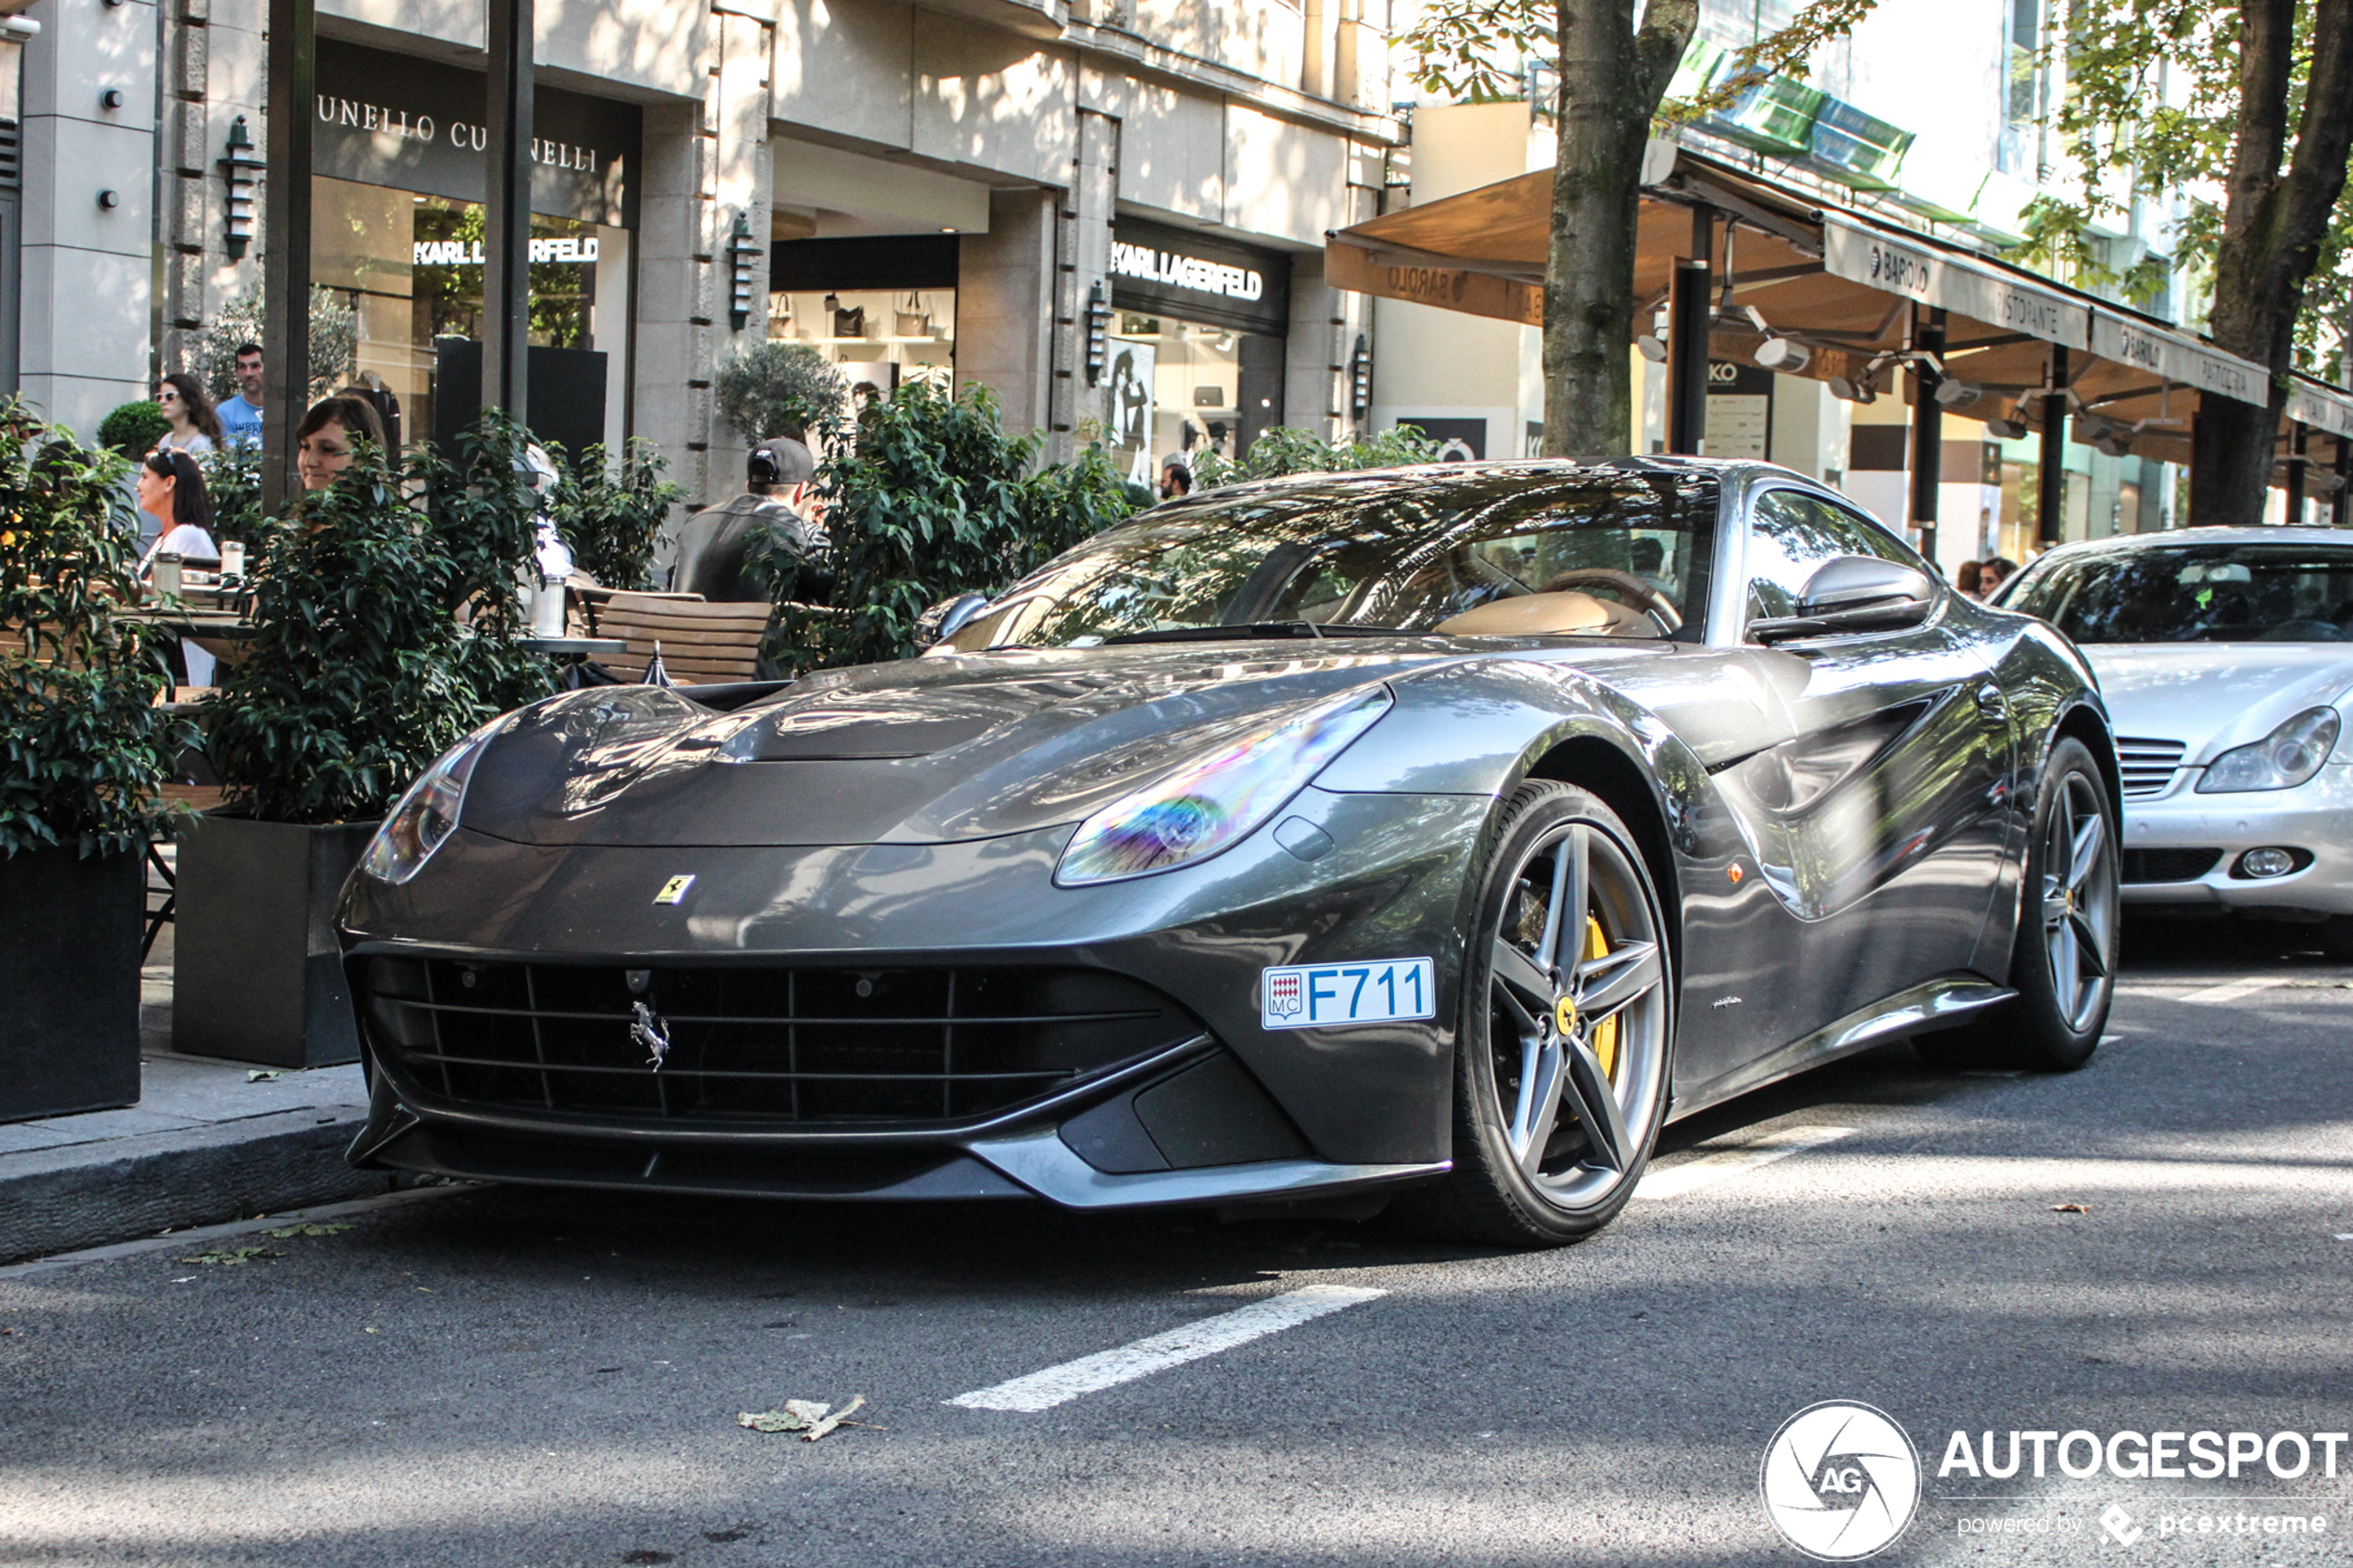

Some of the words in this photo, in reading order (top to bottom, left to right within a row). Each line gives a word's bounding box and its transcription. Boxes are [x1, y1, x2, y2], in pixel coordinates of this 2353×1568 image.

[318, 94, 435, 141] UNELLO
[451, 121, 597, 173] CUNELLI
[413, 240, 471, 265] KARL
[472, 237, 599, 264] LRFELD
[1111, 241, 1159, 281] KARL
[1160, 251, 1263, 301] LAGERFELD
[1883, 252, 1929, 294] BAROLO
[1272, 997, 1299, 1012] MC
[1309, 964, 1423, 1021] F711
